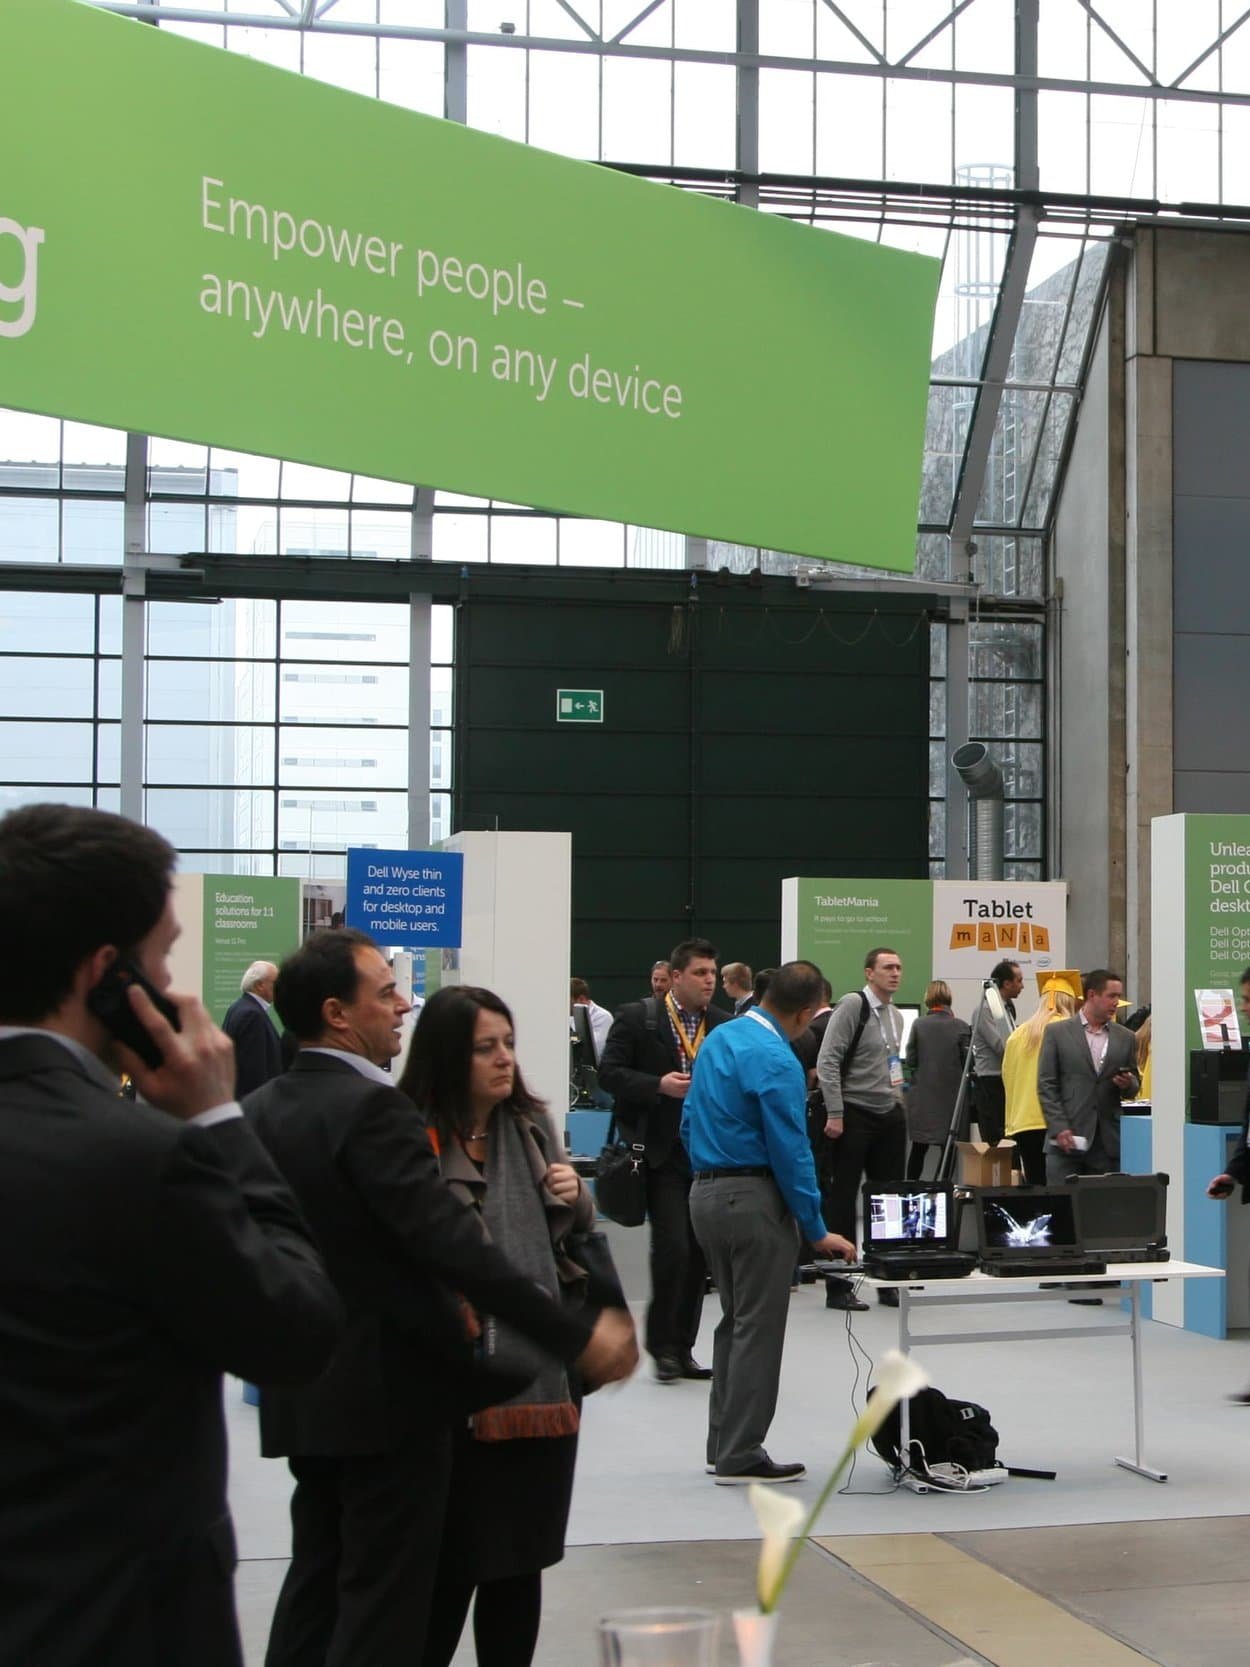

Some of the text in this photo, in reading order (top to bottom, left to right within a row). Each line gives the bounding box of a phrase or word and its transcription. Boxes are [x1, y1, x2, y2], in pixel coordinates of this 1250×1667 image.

[202, 176, 403, 277] Empower
[417, 249, 547, 316] people
[200, 272, 682, 418] anywhere, on any device
[367, 865, 442, 882] Dell Wyse thin
[363, 883, 446, 898] and zero clients
[1209, 879, 1240, 894] Dell
[215, 892, 254, 904] Education
[815, 895, 879, 907] TabletMania
[215, 906, 250, 917] solutions
[251, 906, 262, 917] for
[363, 899, 445, 917] for desktop and
[962, 899, 1033, 919] Tablet
[215, 918, 258, 929] classrooms
[370, 918, 440, 932] mobile users.
[1209, 926, 1229, 937] Dell
[1209, 938, 1229, 949] Dell
[1209, 950, 1229, 961] Dell
